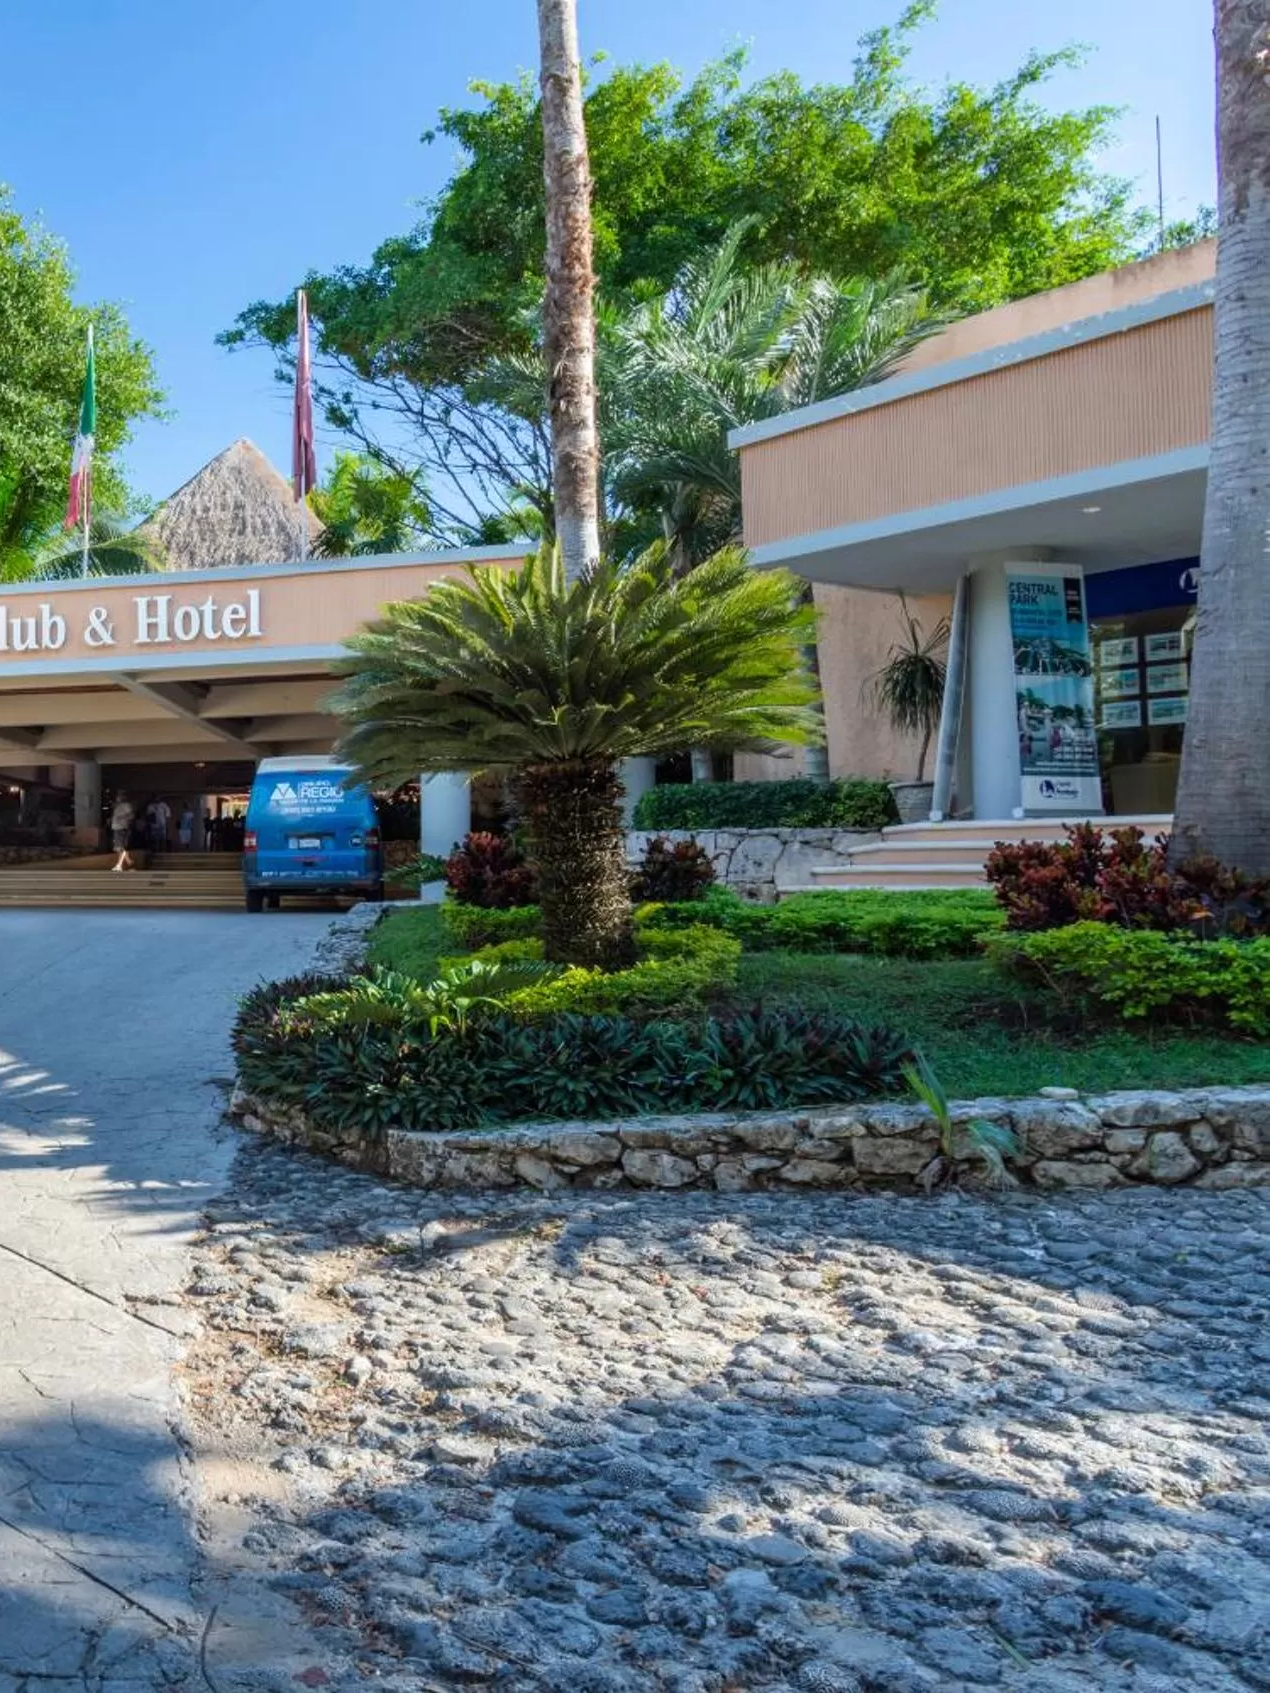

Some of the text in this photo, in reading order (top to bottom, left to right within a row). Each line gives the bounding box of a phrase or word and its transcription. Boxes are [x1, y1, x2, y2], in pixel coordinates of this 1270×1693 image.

[1009, 582, 1059, 596] CENTRAL
[1009, 594, 1039, 606] PARK
[84, 607, 117, 647] &
[132, 588, 262, 644] Hotel
